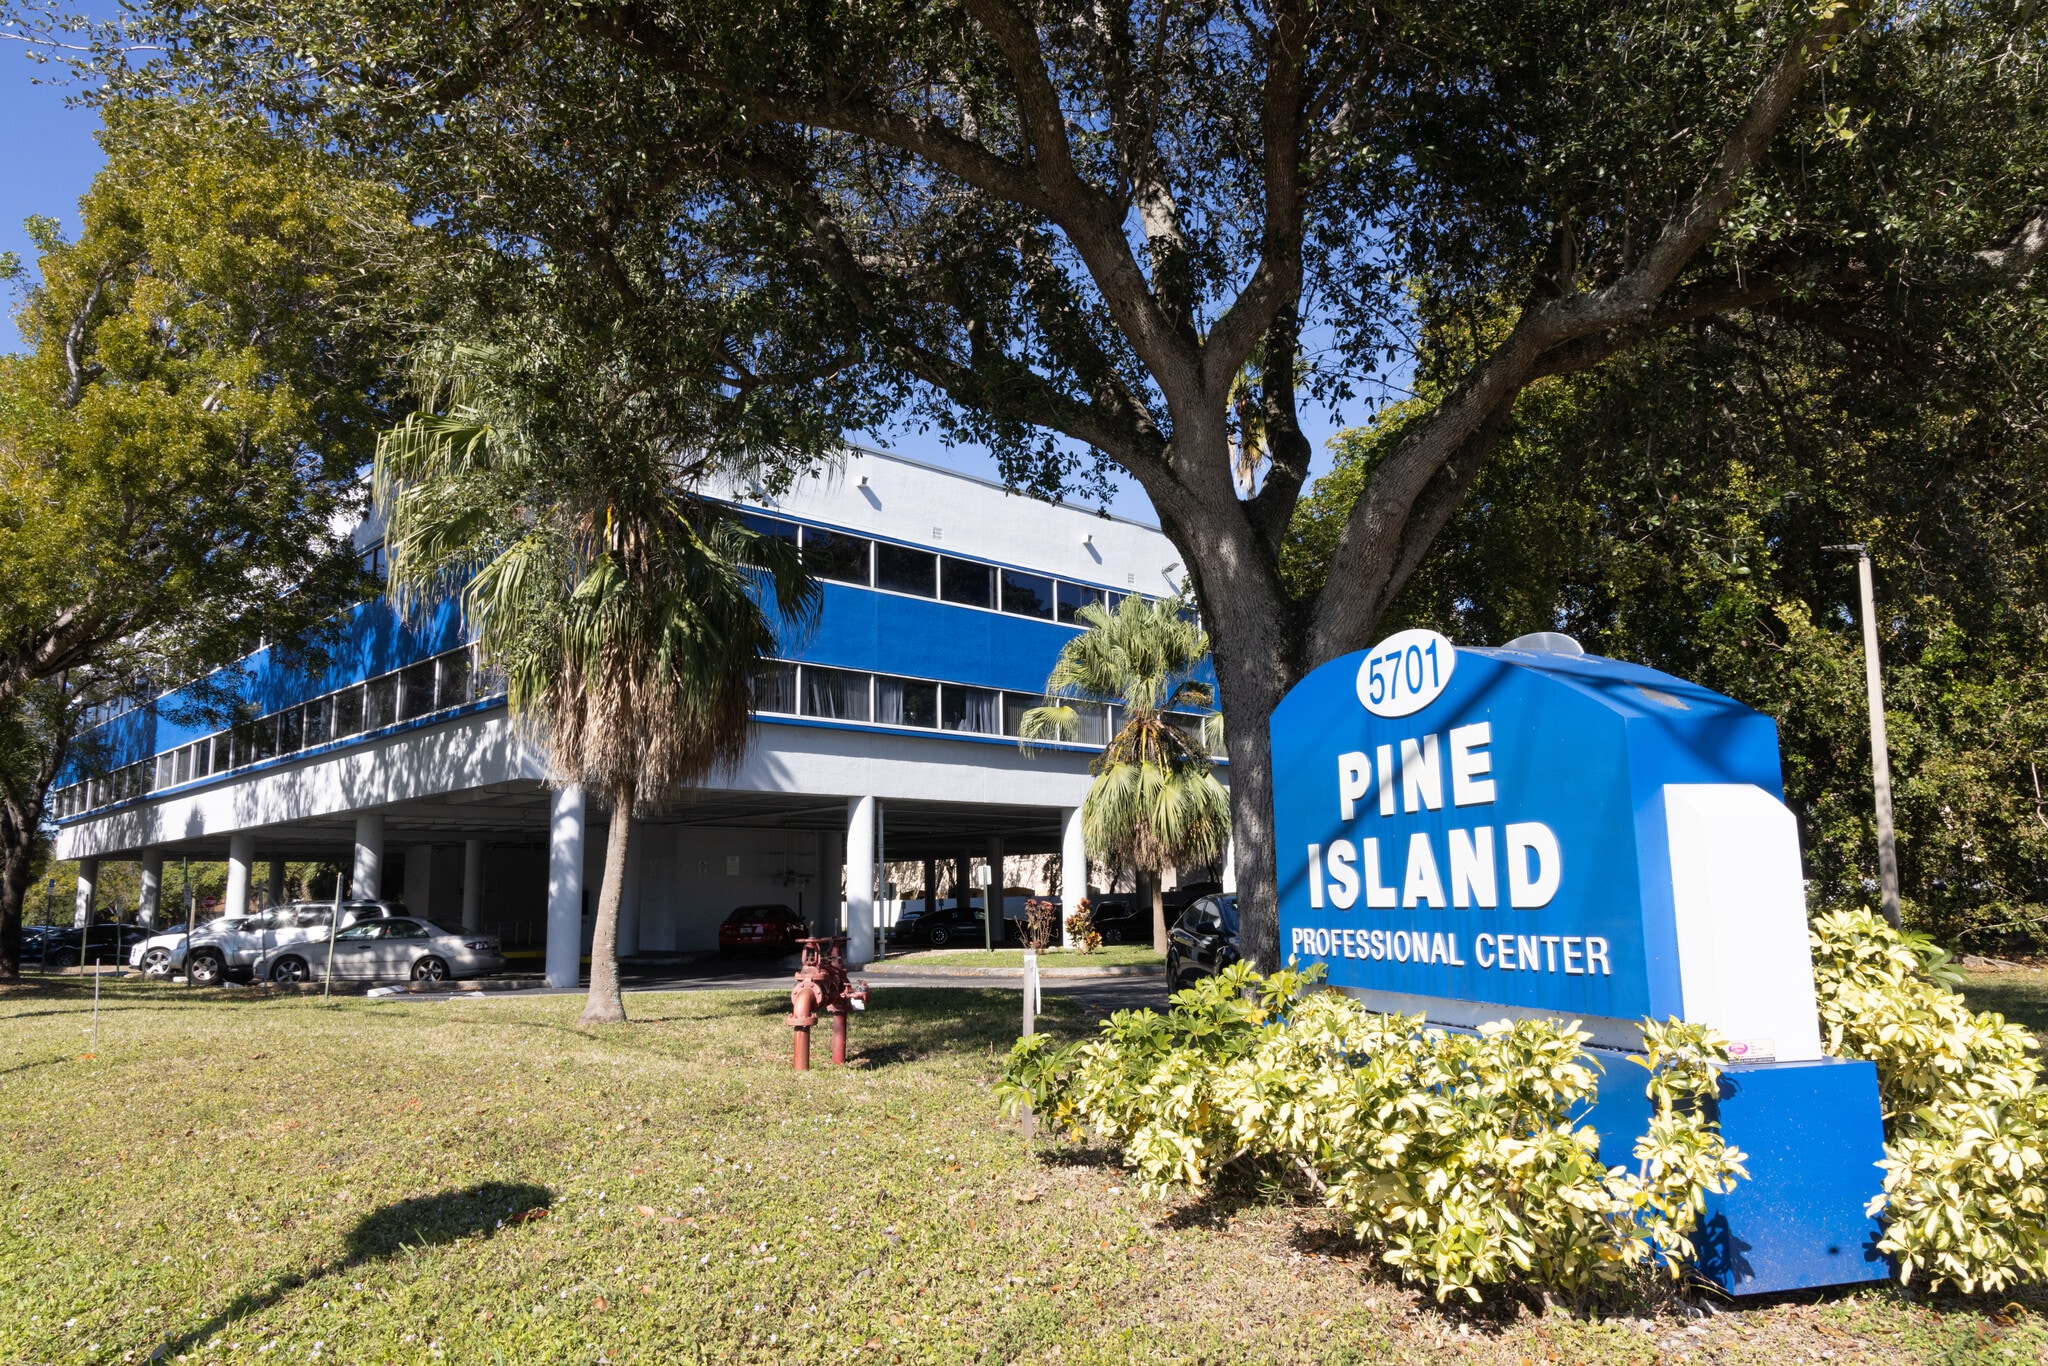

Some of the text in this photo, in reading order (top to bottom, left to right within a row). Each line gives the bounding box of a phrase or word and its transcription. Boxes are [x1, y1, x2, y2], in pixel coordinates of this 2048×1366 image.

[1369, 638, 1439, 704] 5701
[1338, 721, 1497, 820] PINE
[1308, 822, 1562, 909] ISLAND
[1291, 928, 1611, 975] PROFESSIONAL CENTER
